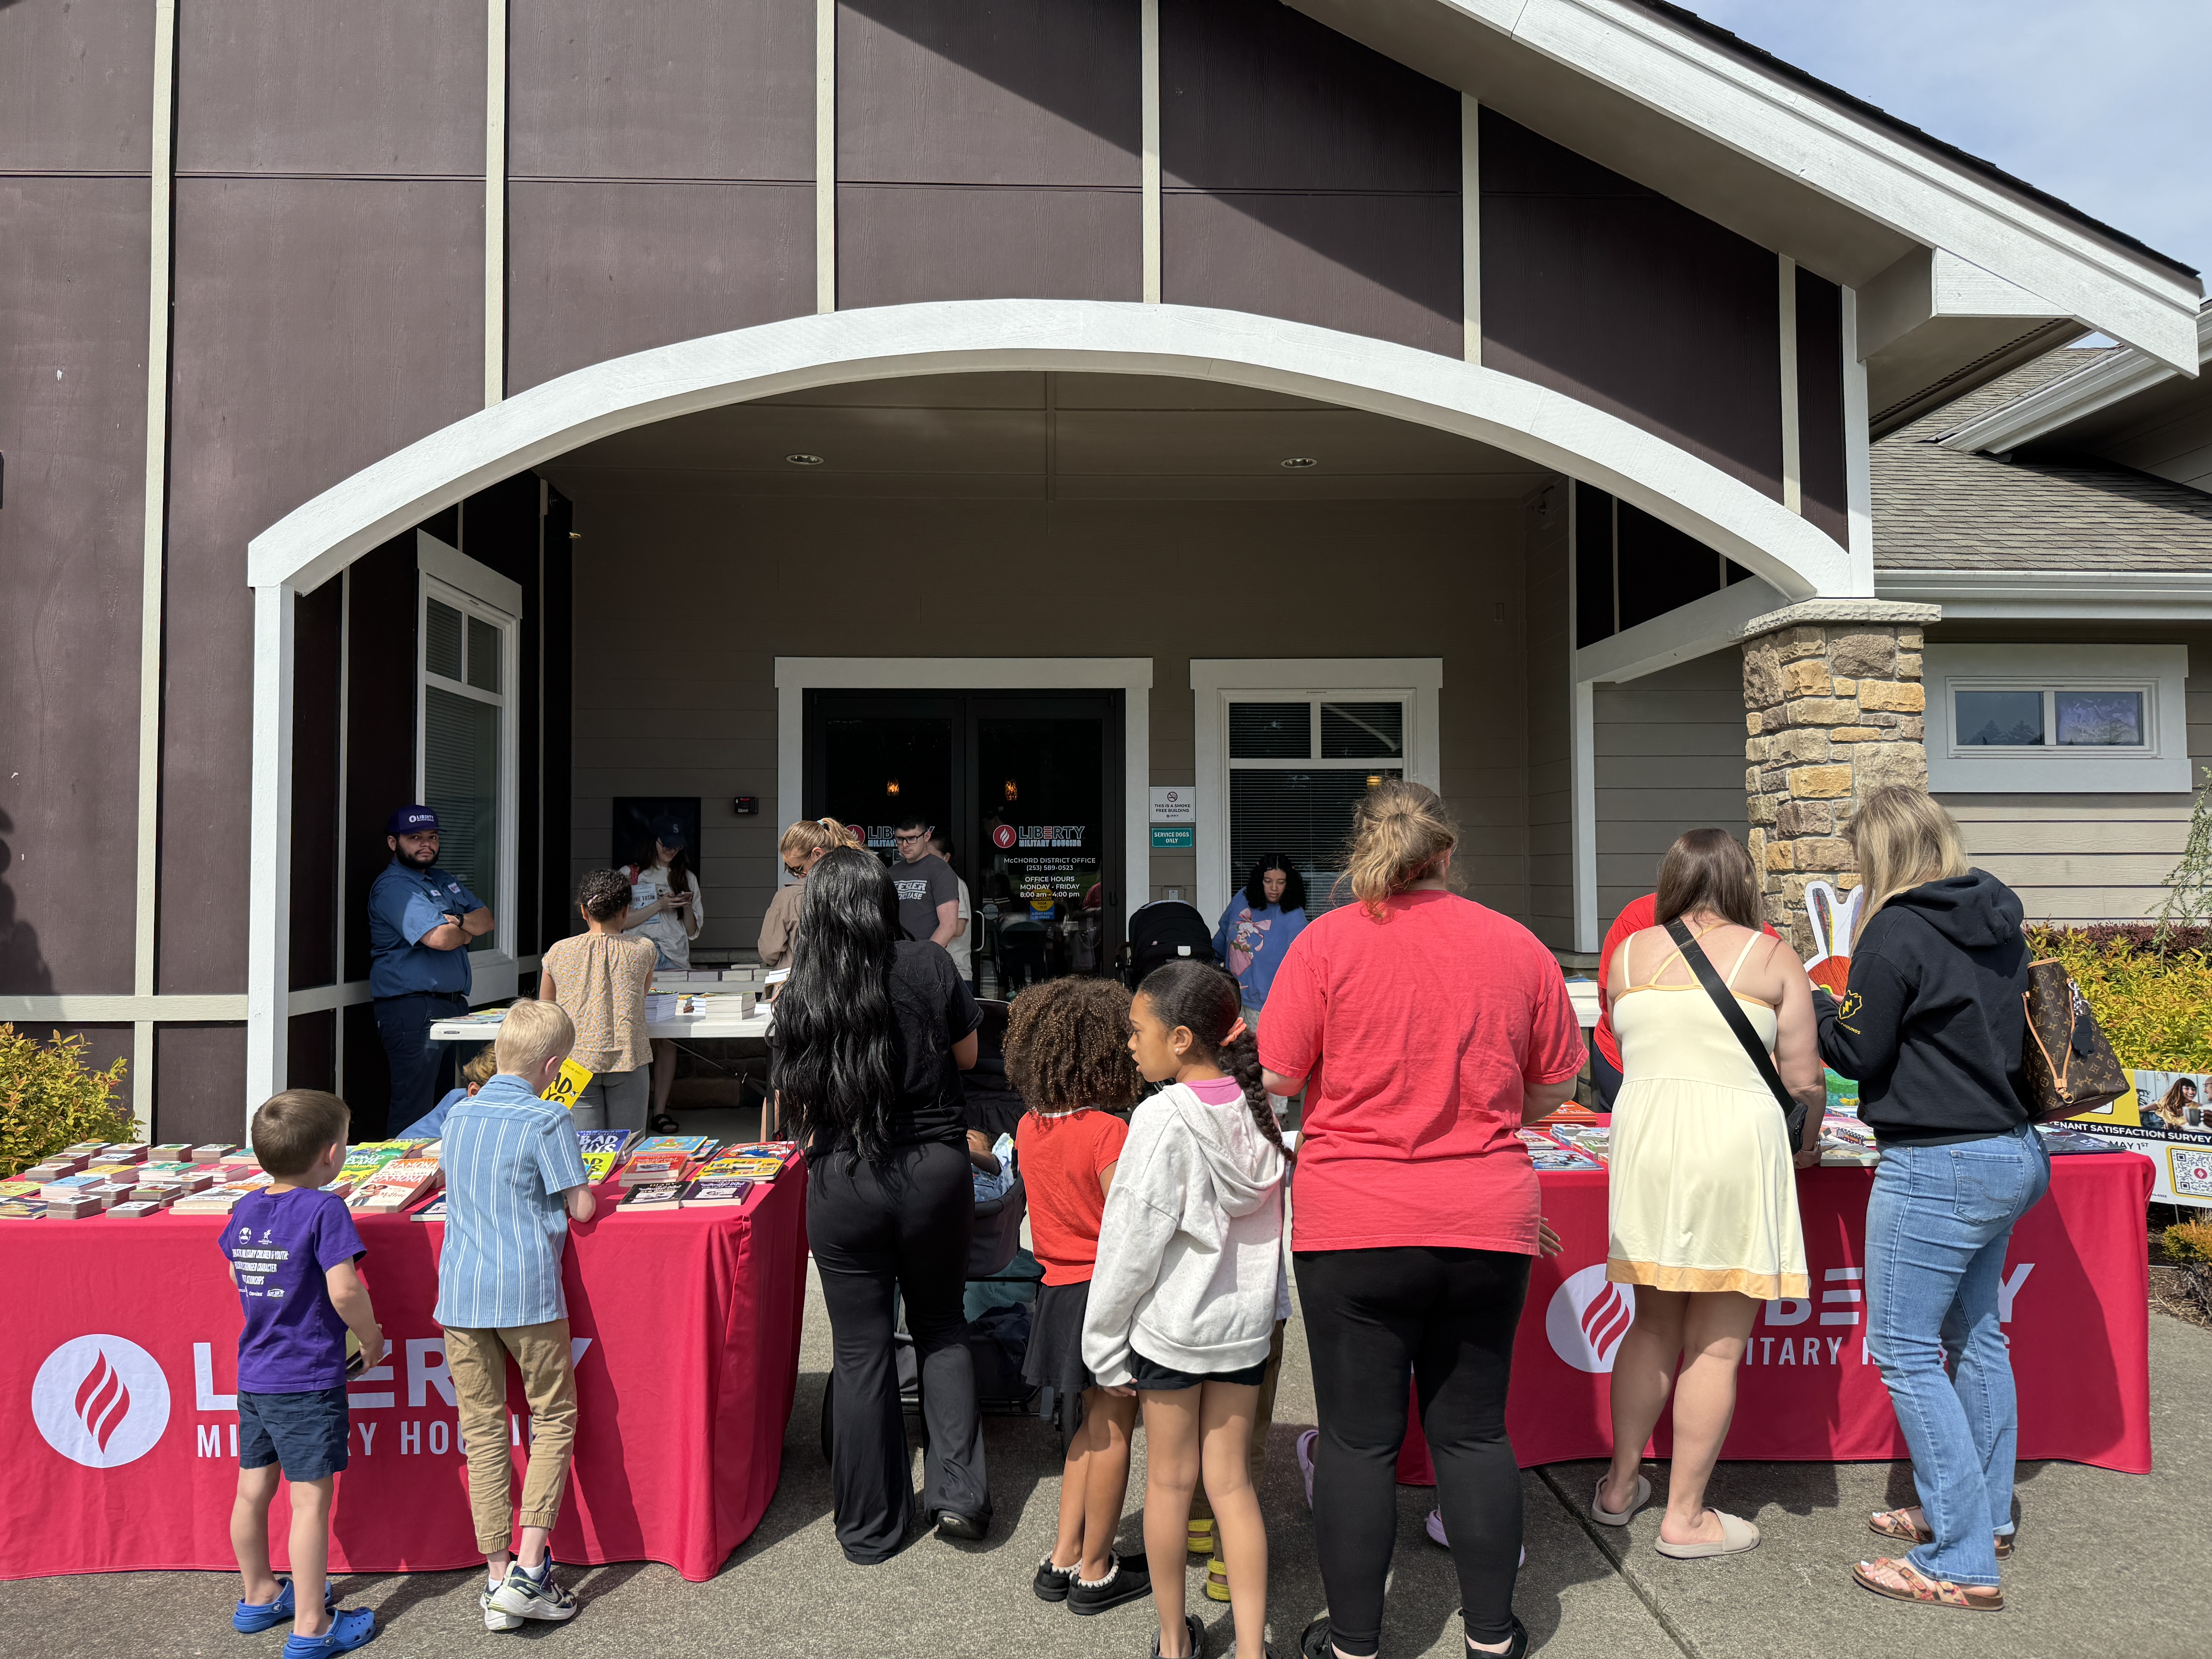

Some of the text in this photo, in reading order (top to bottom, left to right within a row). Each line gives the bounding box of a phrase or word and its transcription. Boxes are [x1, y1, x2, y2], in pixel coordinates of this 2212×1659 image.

[1019, 826, 1085, 839] LIBERTY
[895, 883, 926, 891] ESLER
[555, 1072, 573, 1094] AD
[545, 1086, 565, 1103] YS
[2050, 1121, 2212, 1143] ENANT SATISFACTION SURVEY
[579, 1135, 618, 1145] BAD
[2109, 1140, 2134, 1151] MAY
[581, 1143, 616, 1153] UYS
[386, 1161, 438, 1170] RAMONA
[369, 1175, 424, 1183] RAMONA
[1746, 1336, 1842, 1365] ITARY
